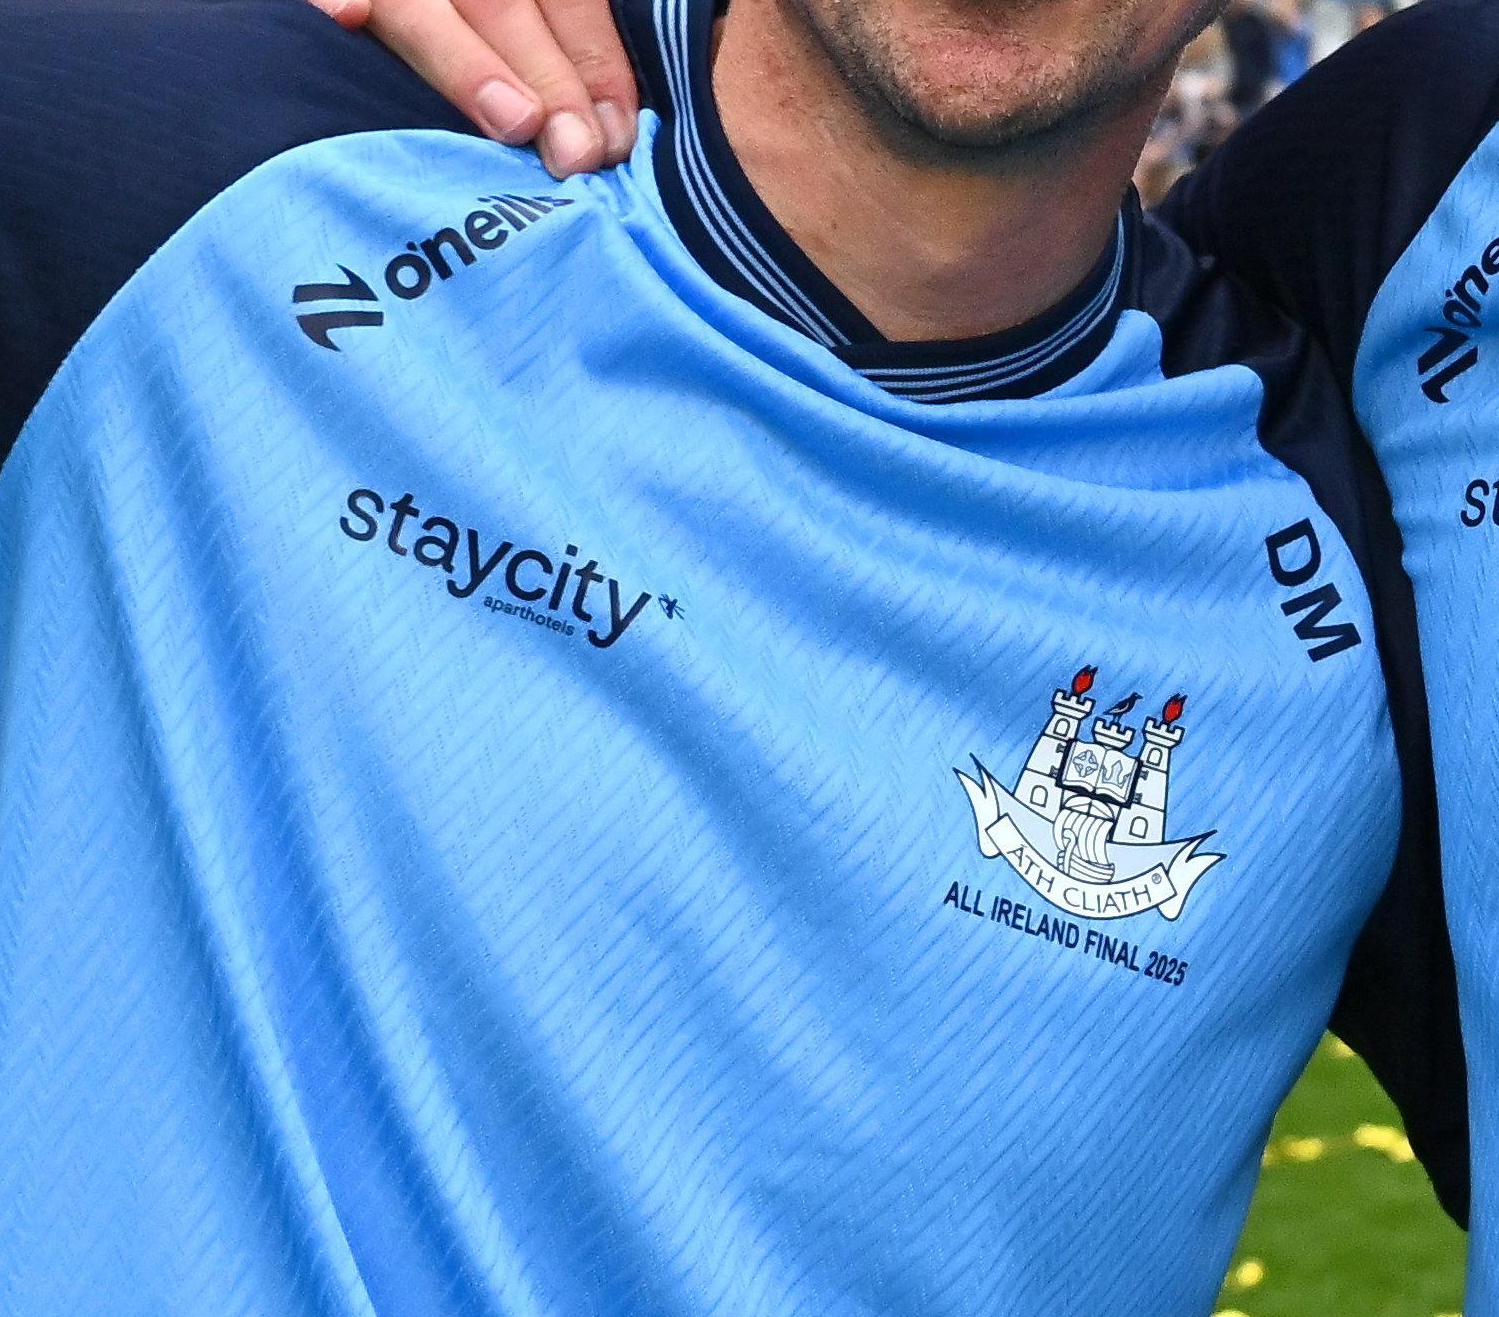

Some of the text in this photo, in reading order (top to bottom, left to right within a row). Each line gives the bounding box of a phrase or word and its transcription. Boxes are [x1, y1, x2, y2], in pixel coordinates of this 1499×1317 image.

[339, 488, 652, 649] staycity
[482, 594, 576, 637] aparthotels
[1264, 517, 1362, 663] DM
[942, 880, 1189, 987] ALL IRELAND FINAL 2025
[1063, 883, 1153, 914] CLIATH
